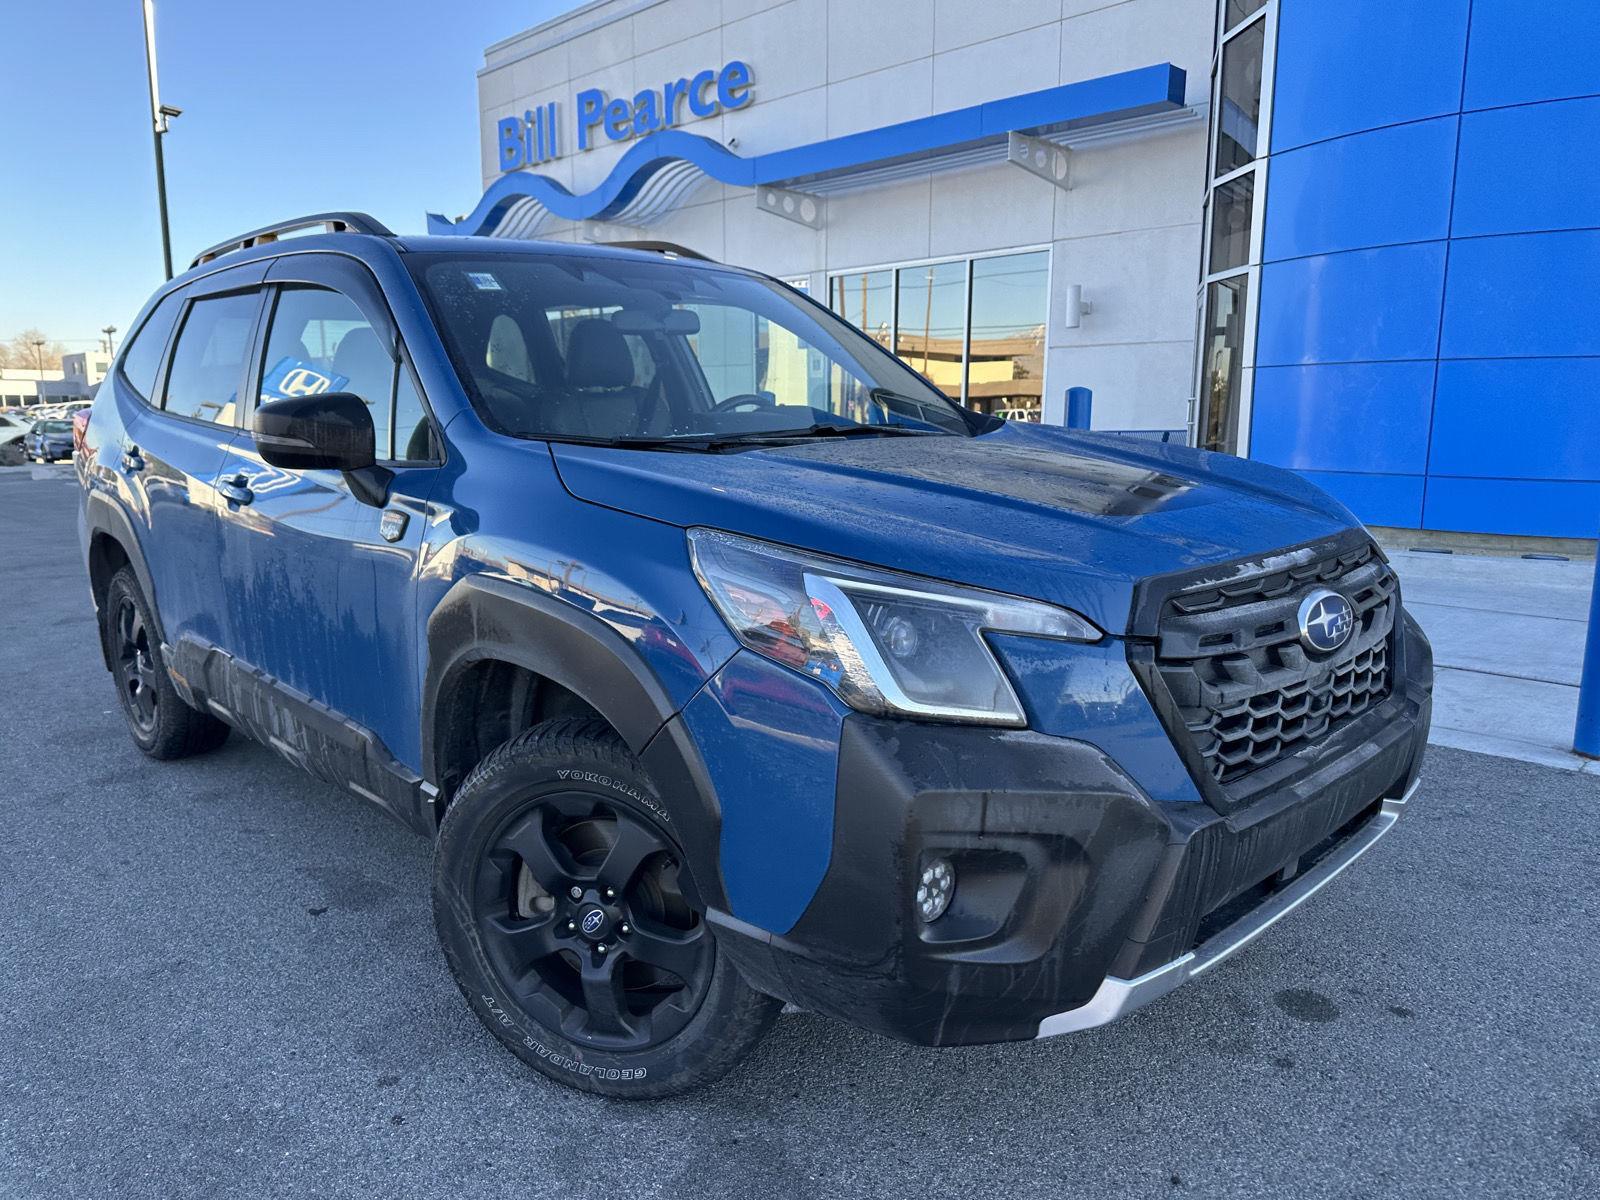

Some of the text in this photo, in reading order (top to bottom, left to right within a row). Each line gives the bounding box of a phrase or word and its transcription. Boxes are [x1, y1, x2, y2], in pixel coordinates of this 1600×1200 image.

[498, 60, 754, 172] Bill Pearce
[557, 769, 670, 822] YOKOHAMA
[523, 1036, 647, 1080] GEOLANDAR
